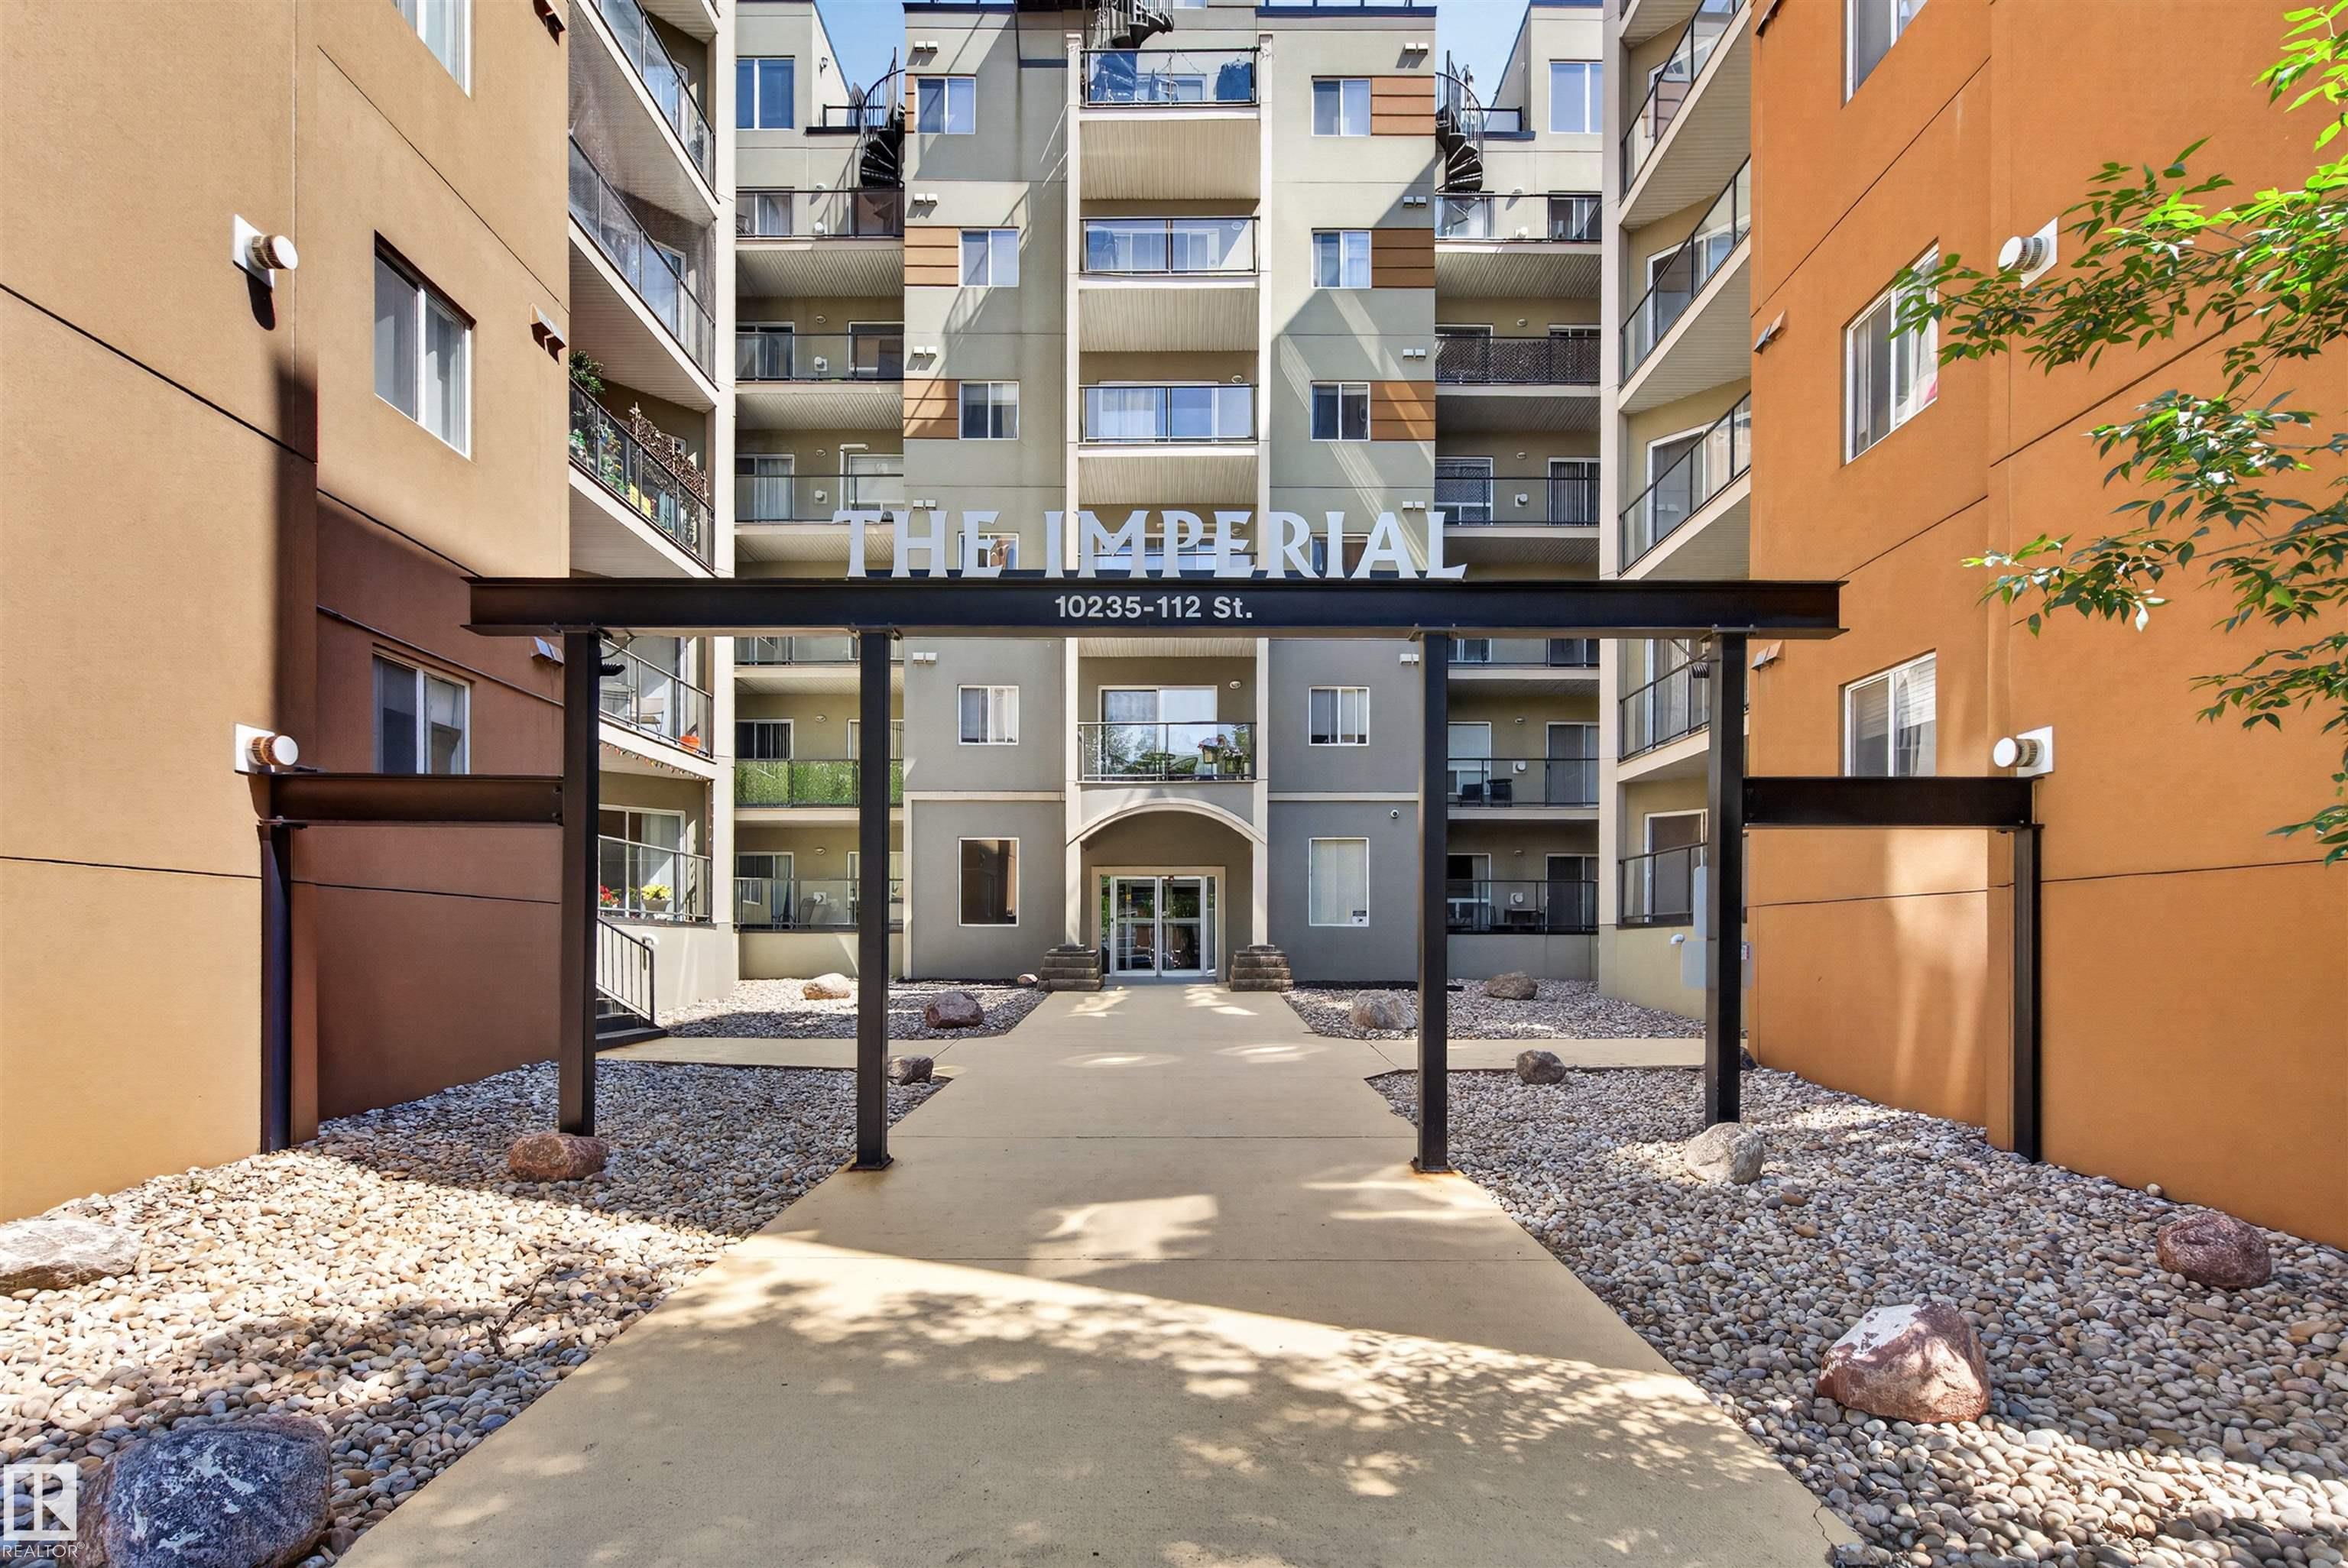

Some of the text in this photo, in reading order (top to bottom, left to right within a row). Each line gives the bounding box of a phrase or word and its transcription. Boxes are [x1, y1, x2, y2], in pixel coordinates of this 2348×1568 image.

[832, 510, 1467, 579] THE IMPERIAL
[1055, 595, 1253, 618] 10235-112 St.
